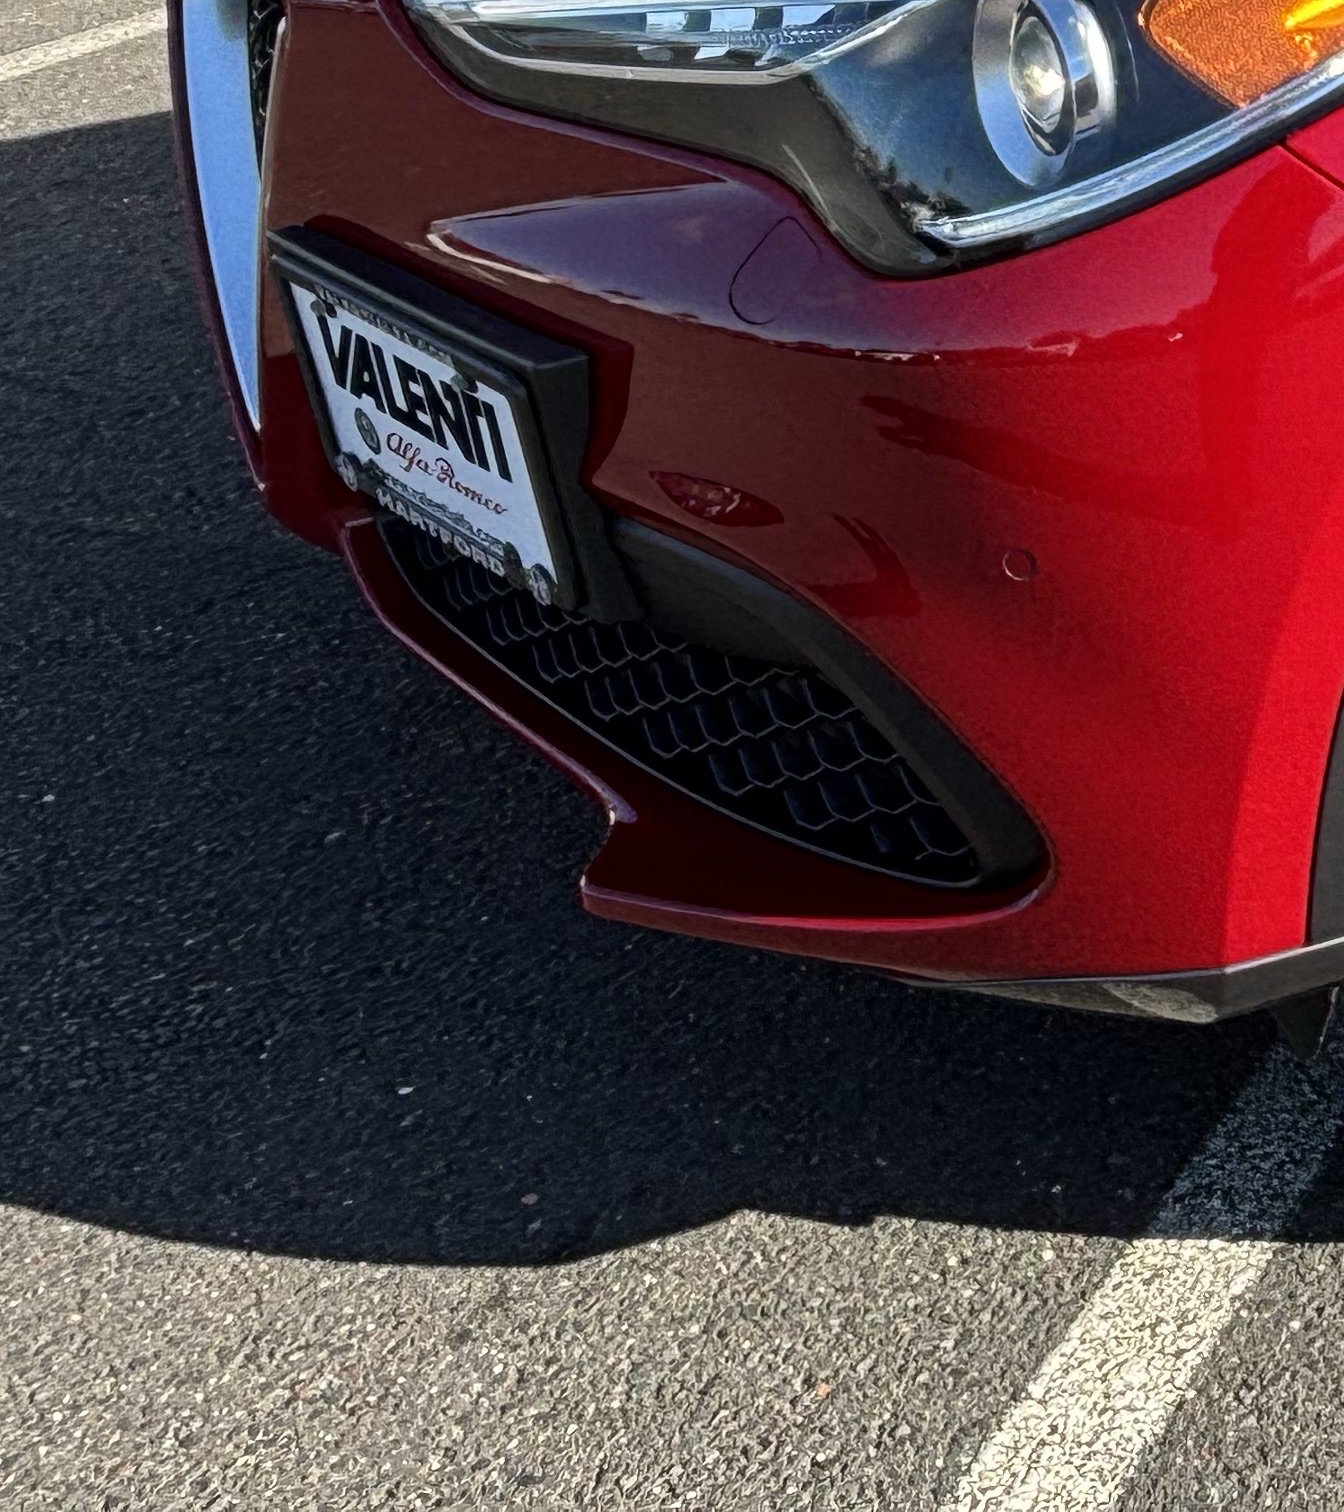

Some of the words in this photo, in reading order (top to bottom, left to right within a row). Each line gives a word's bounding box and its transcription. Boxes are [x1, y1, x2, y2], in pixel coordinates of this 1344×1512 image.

[317, 314, 513, 484] VALENTI
[386, 432, 434, 473] Alfa
[434, 456, 508, 516] Romeo
